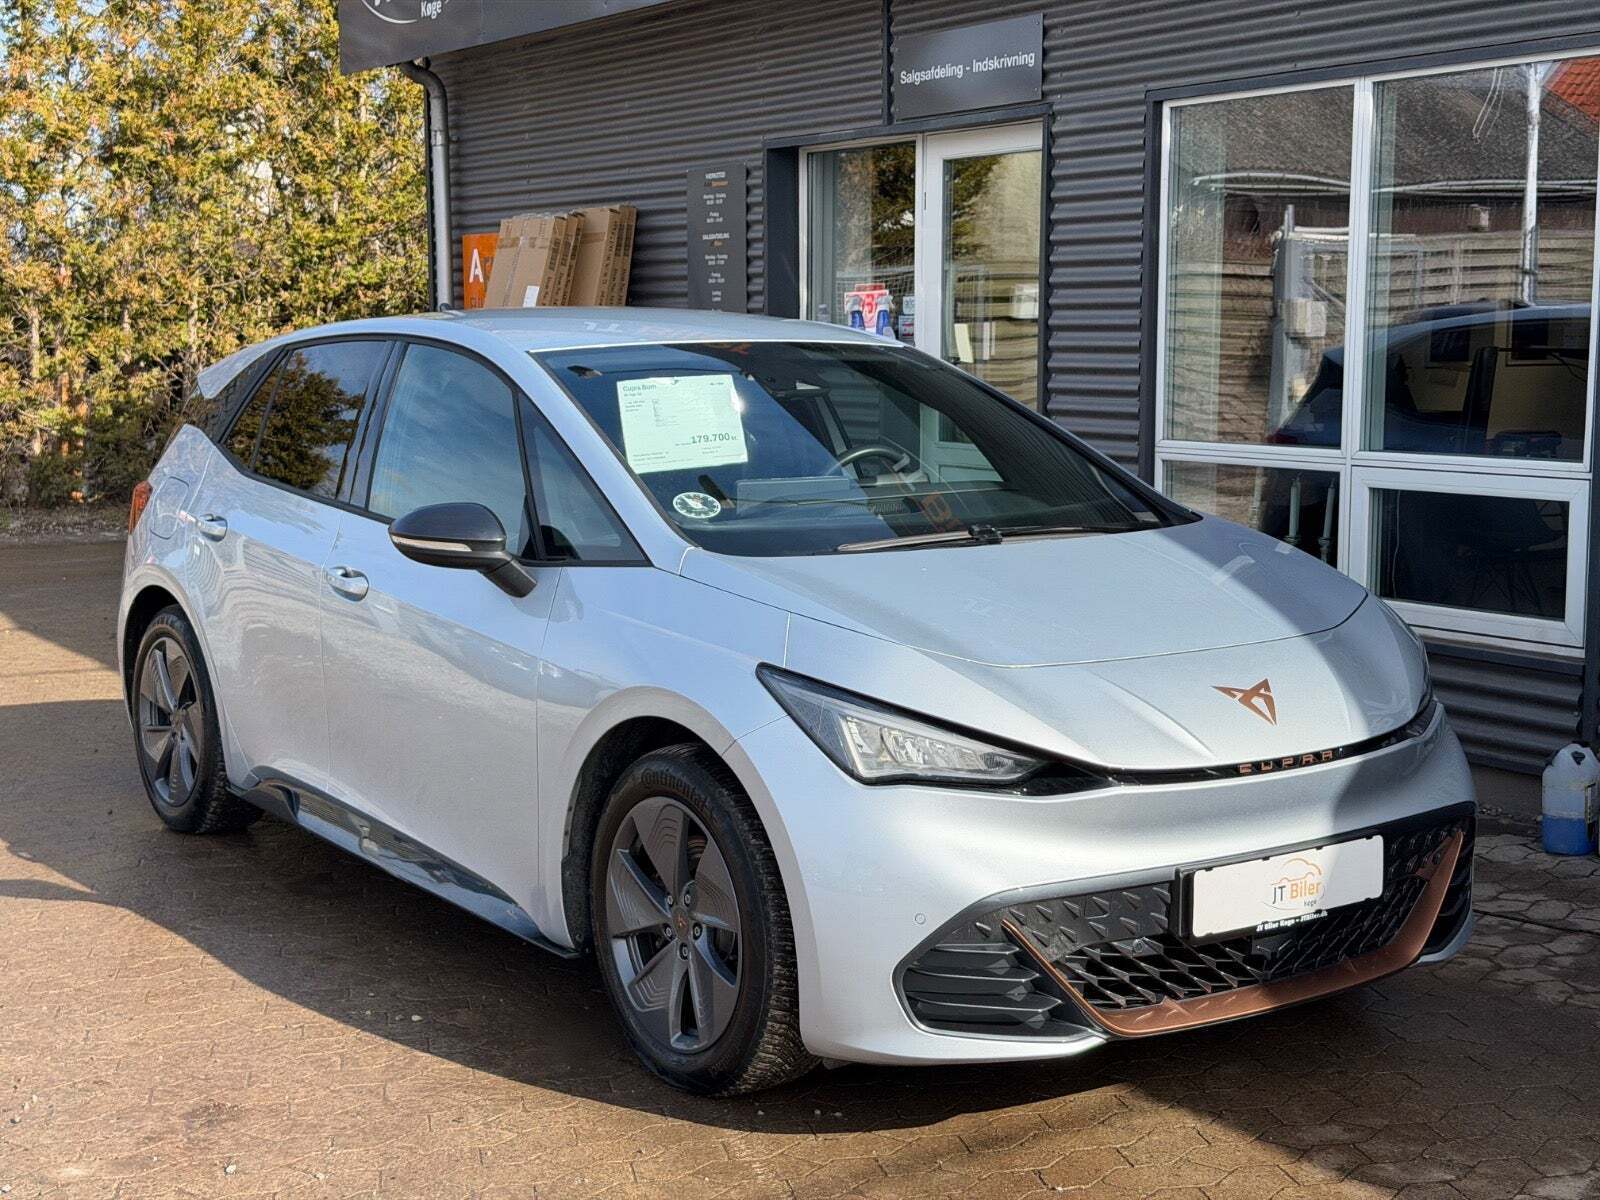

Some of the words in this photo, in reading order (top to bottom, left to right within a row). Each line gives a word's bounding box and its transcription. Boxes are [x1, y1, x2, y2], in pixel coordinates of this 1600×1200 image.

[420, 0, 442, 19] Køge
[900, 63, 964, 85] Salgsafdeling
[972, 51, 1035, 73] Indskrivning
[691, 432, 730, 444] 179.700
[1238, 750, 1333, 773] CUPRA
[1272, 885, 1286, 905] JT
[1290, 880, 1322, 900] Biler
